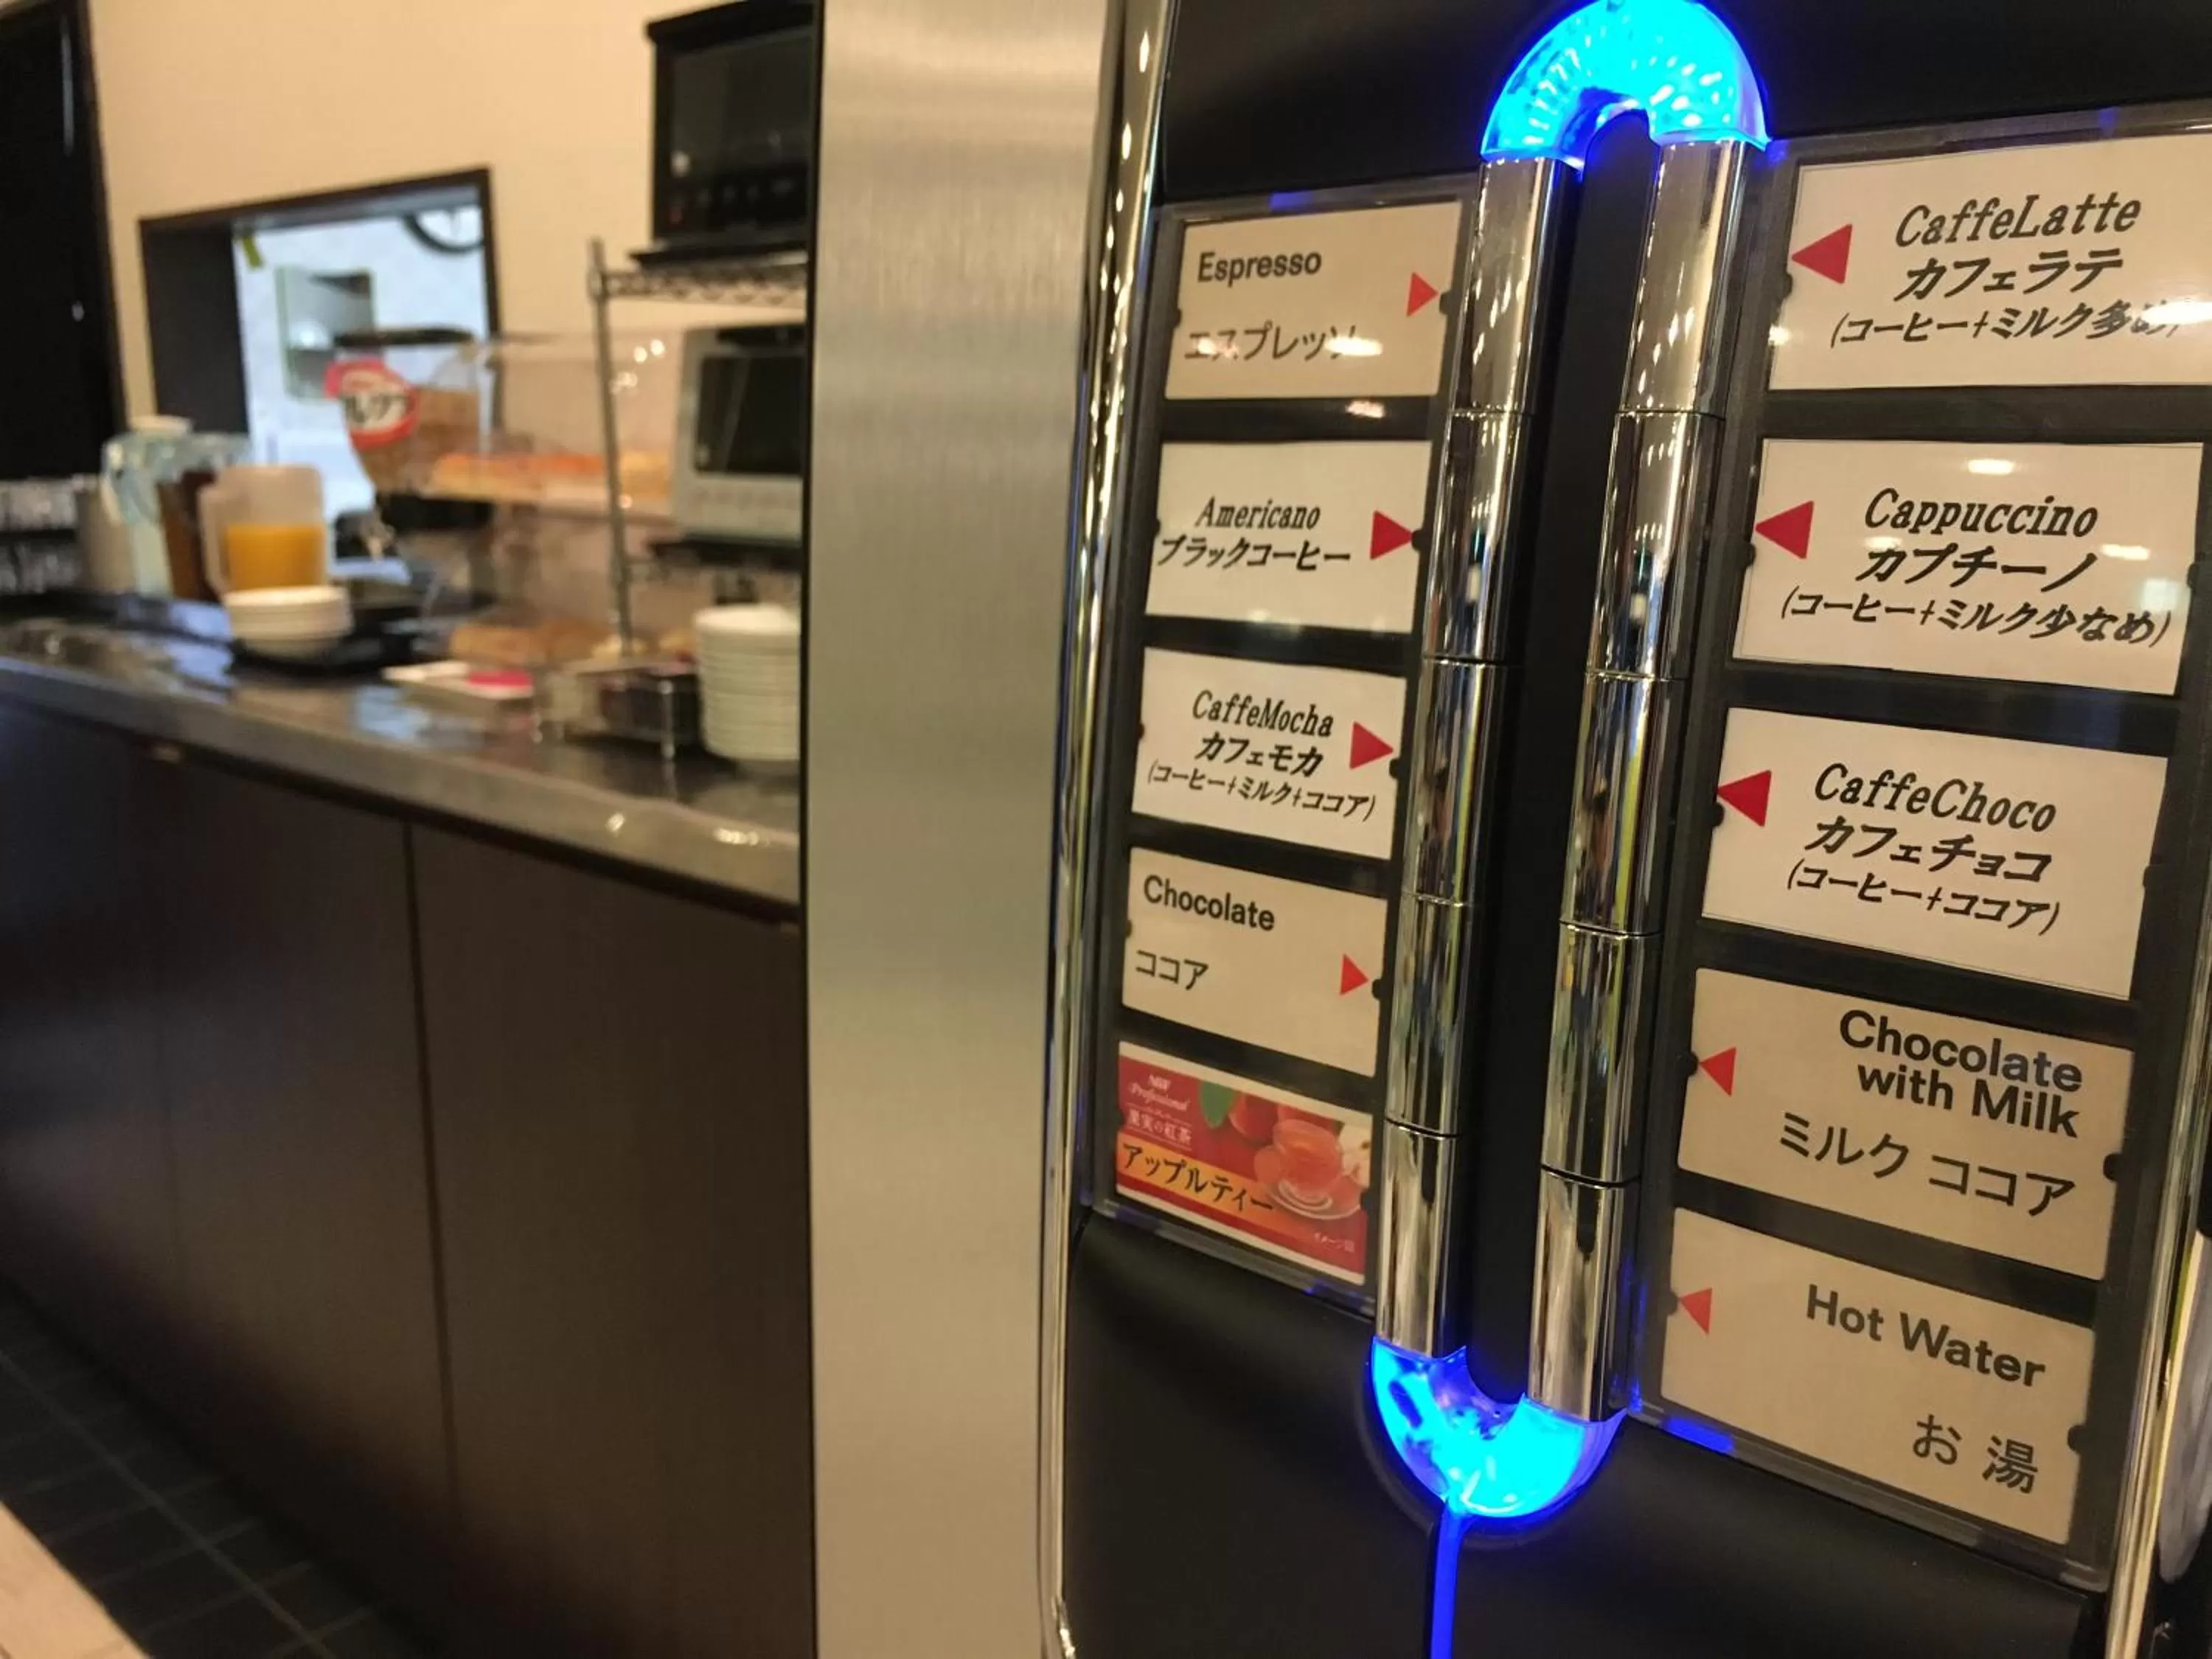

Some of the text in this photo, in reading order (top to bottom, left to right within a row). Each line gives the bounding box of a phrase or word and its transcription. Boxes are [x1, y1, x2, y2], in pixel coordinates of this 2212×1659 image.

[1895, 191, 2141, 248] CaffeLatte
[1197, 250, 1323, 288] Espresso
[1893, 248, 2124, 302] カフェラテ
[1194, 496, 1321, 530] Americano
[1864, 487, 2099, 538] Cappuccino
[1157, 534, 1351, 571] ブラックコーヒー
[1855, 541, 2098, 594] カプチーノ
[1192, 689, 1335, 738] CaffeMocha
[1194, 731, 1324, 778] カフェモカ
[1814, 762, 2057, 832] CaffeChoco
[1804, 815, 2053, 883] カフェチョコ
[1143, 874, 1275, 932] Chocolate
[1135, 948, 1209, 990] ココア
[1839, 1009, 2083, 1093] Chocolate
[1857, 1064, 2080, 1138] with Milk
[1123, 1142, 1274, 1213] アップルティー
[1780, 1111, 2076, 1217] ミルク ココア
[1806, 1284, 2046, 1387] Hot Water
